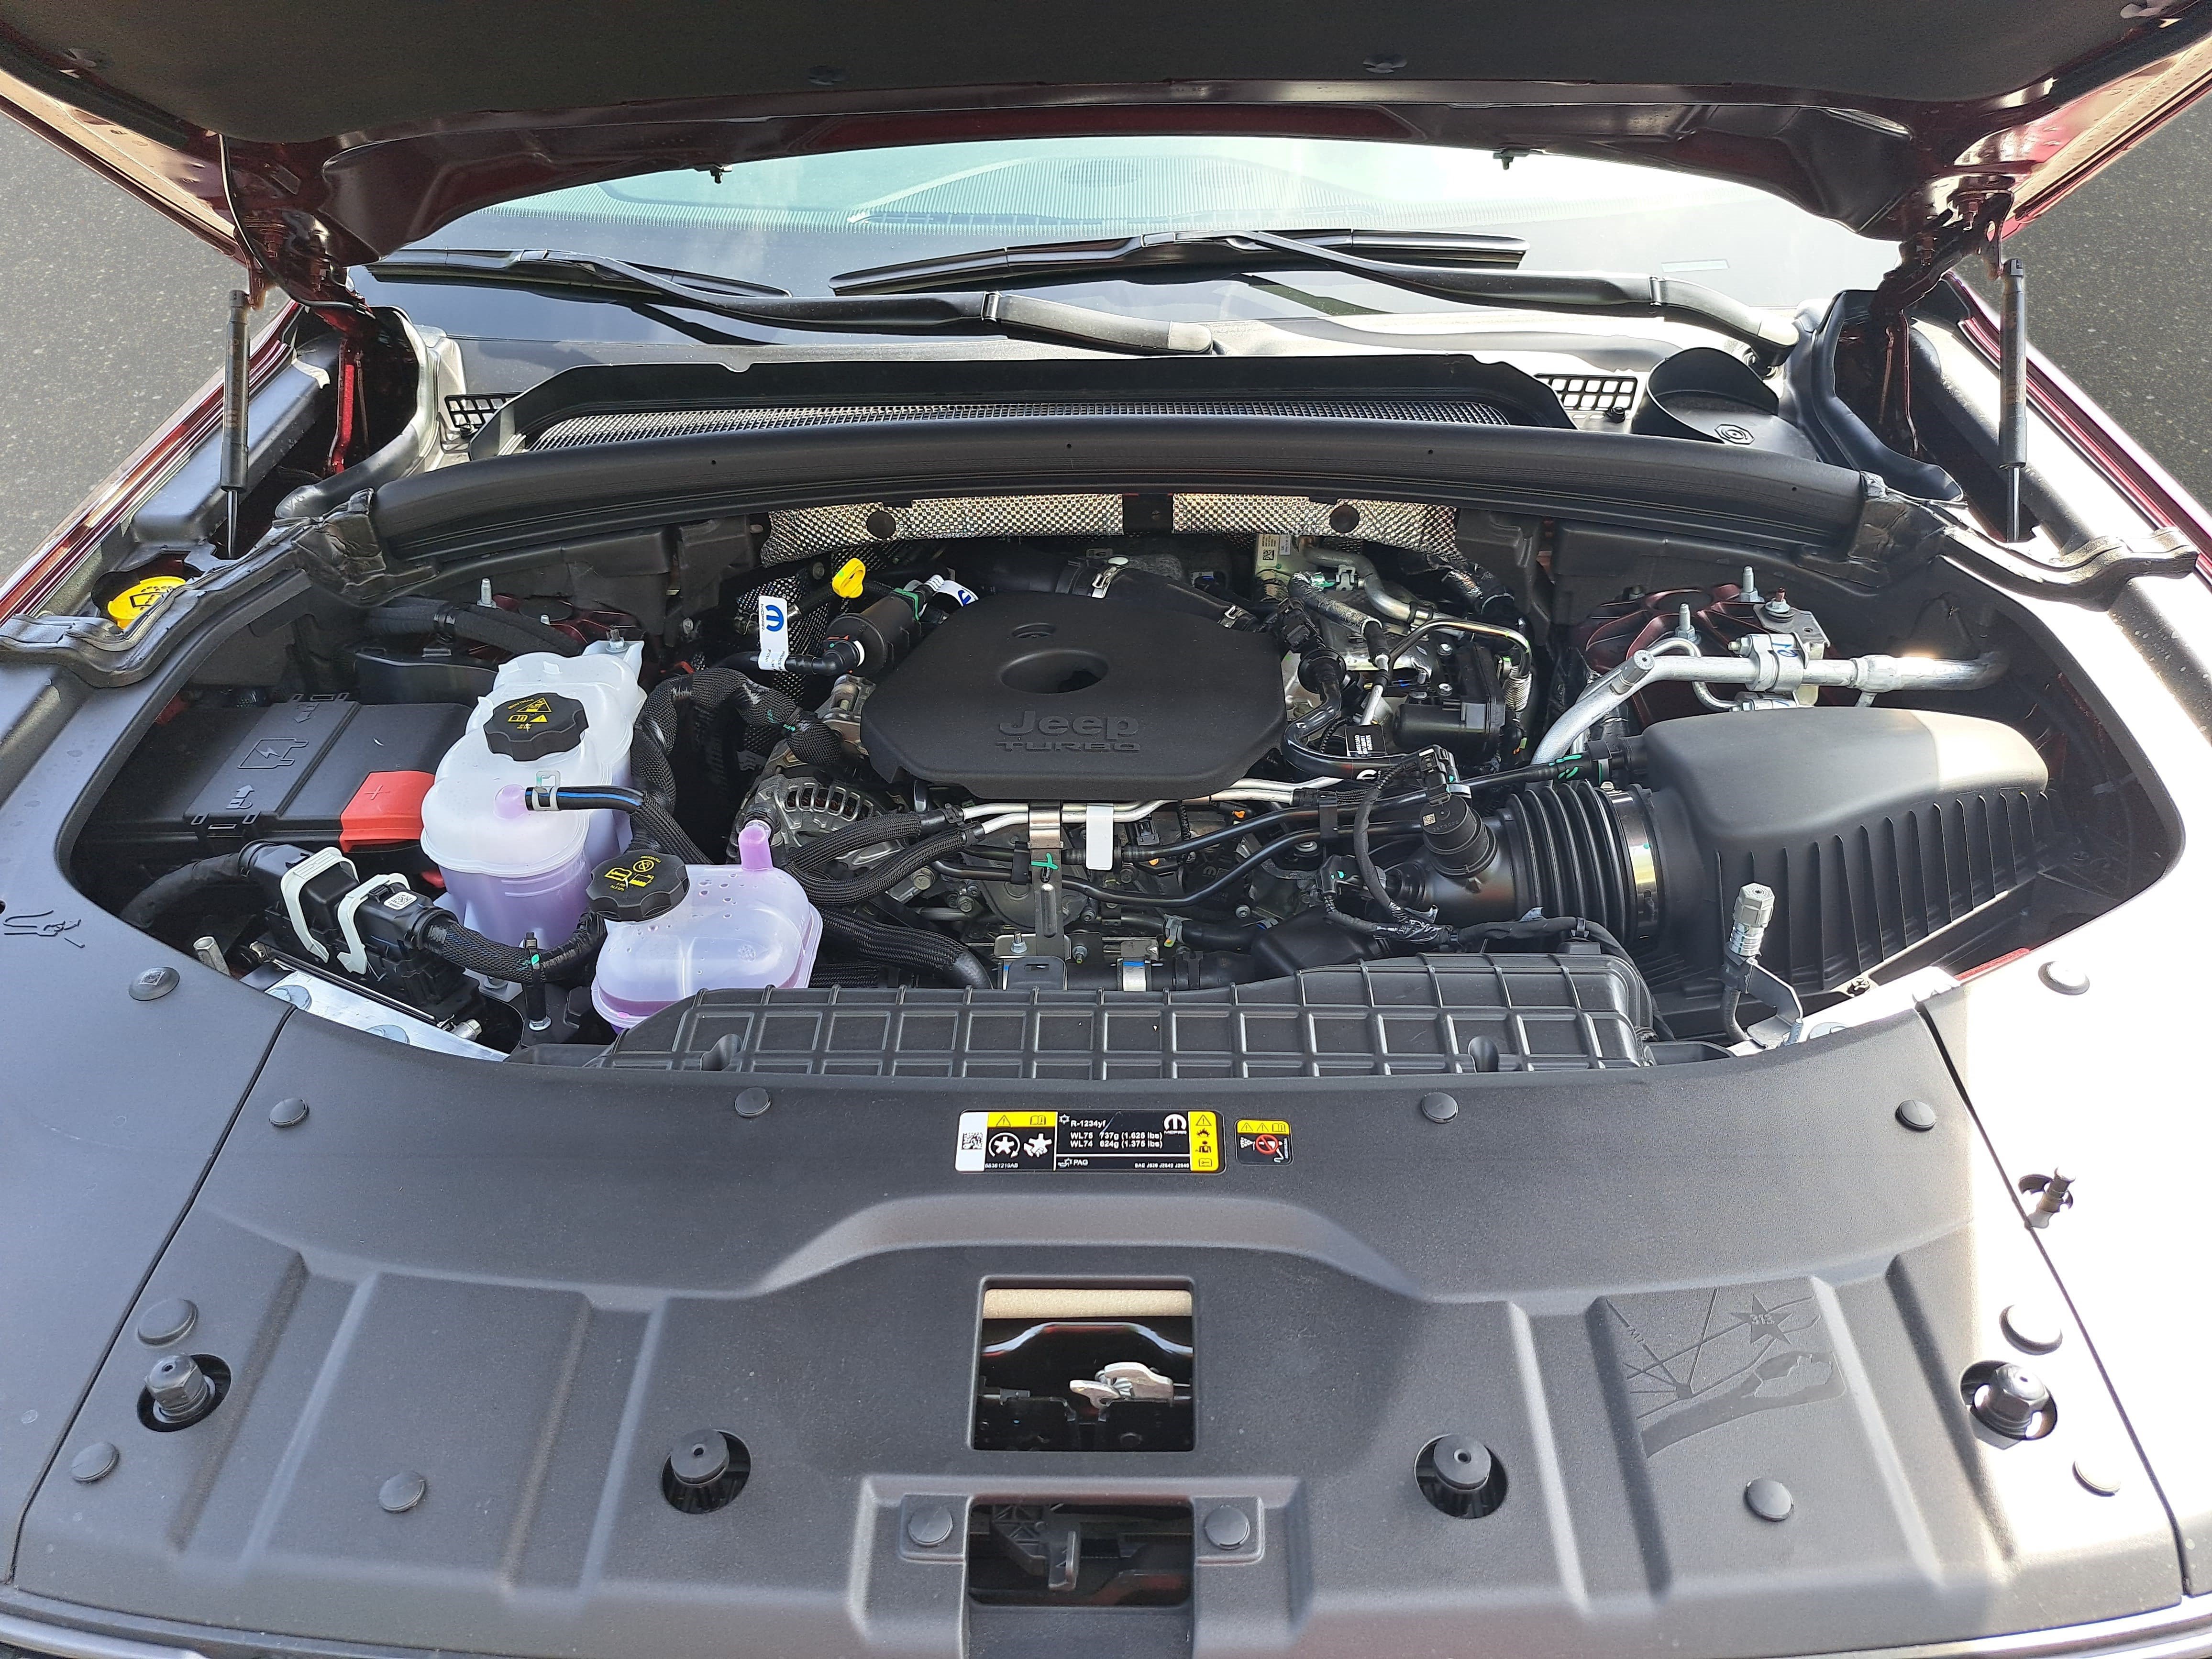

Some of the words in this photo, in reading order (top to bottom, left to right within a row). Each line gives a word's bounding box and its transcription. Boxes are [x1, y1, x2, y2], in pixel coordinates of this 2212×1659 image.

[999, 710, 1139, 741] Jeep
[995, 741, 1141, 752] TURBO
[1100, 1132, 1119, 1140] 737g
[1147, 1132, 1162, 1140] lbs)
[1148, 1140, 1163, 1149] lbs)
